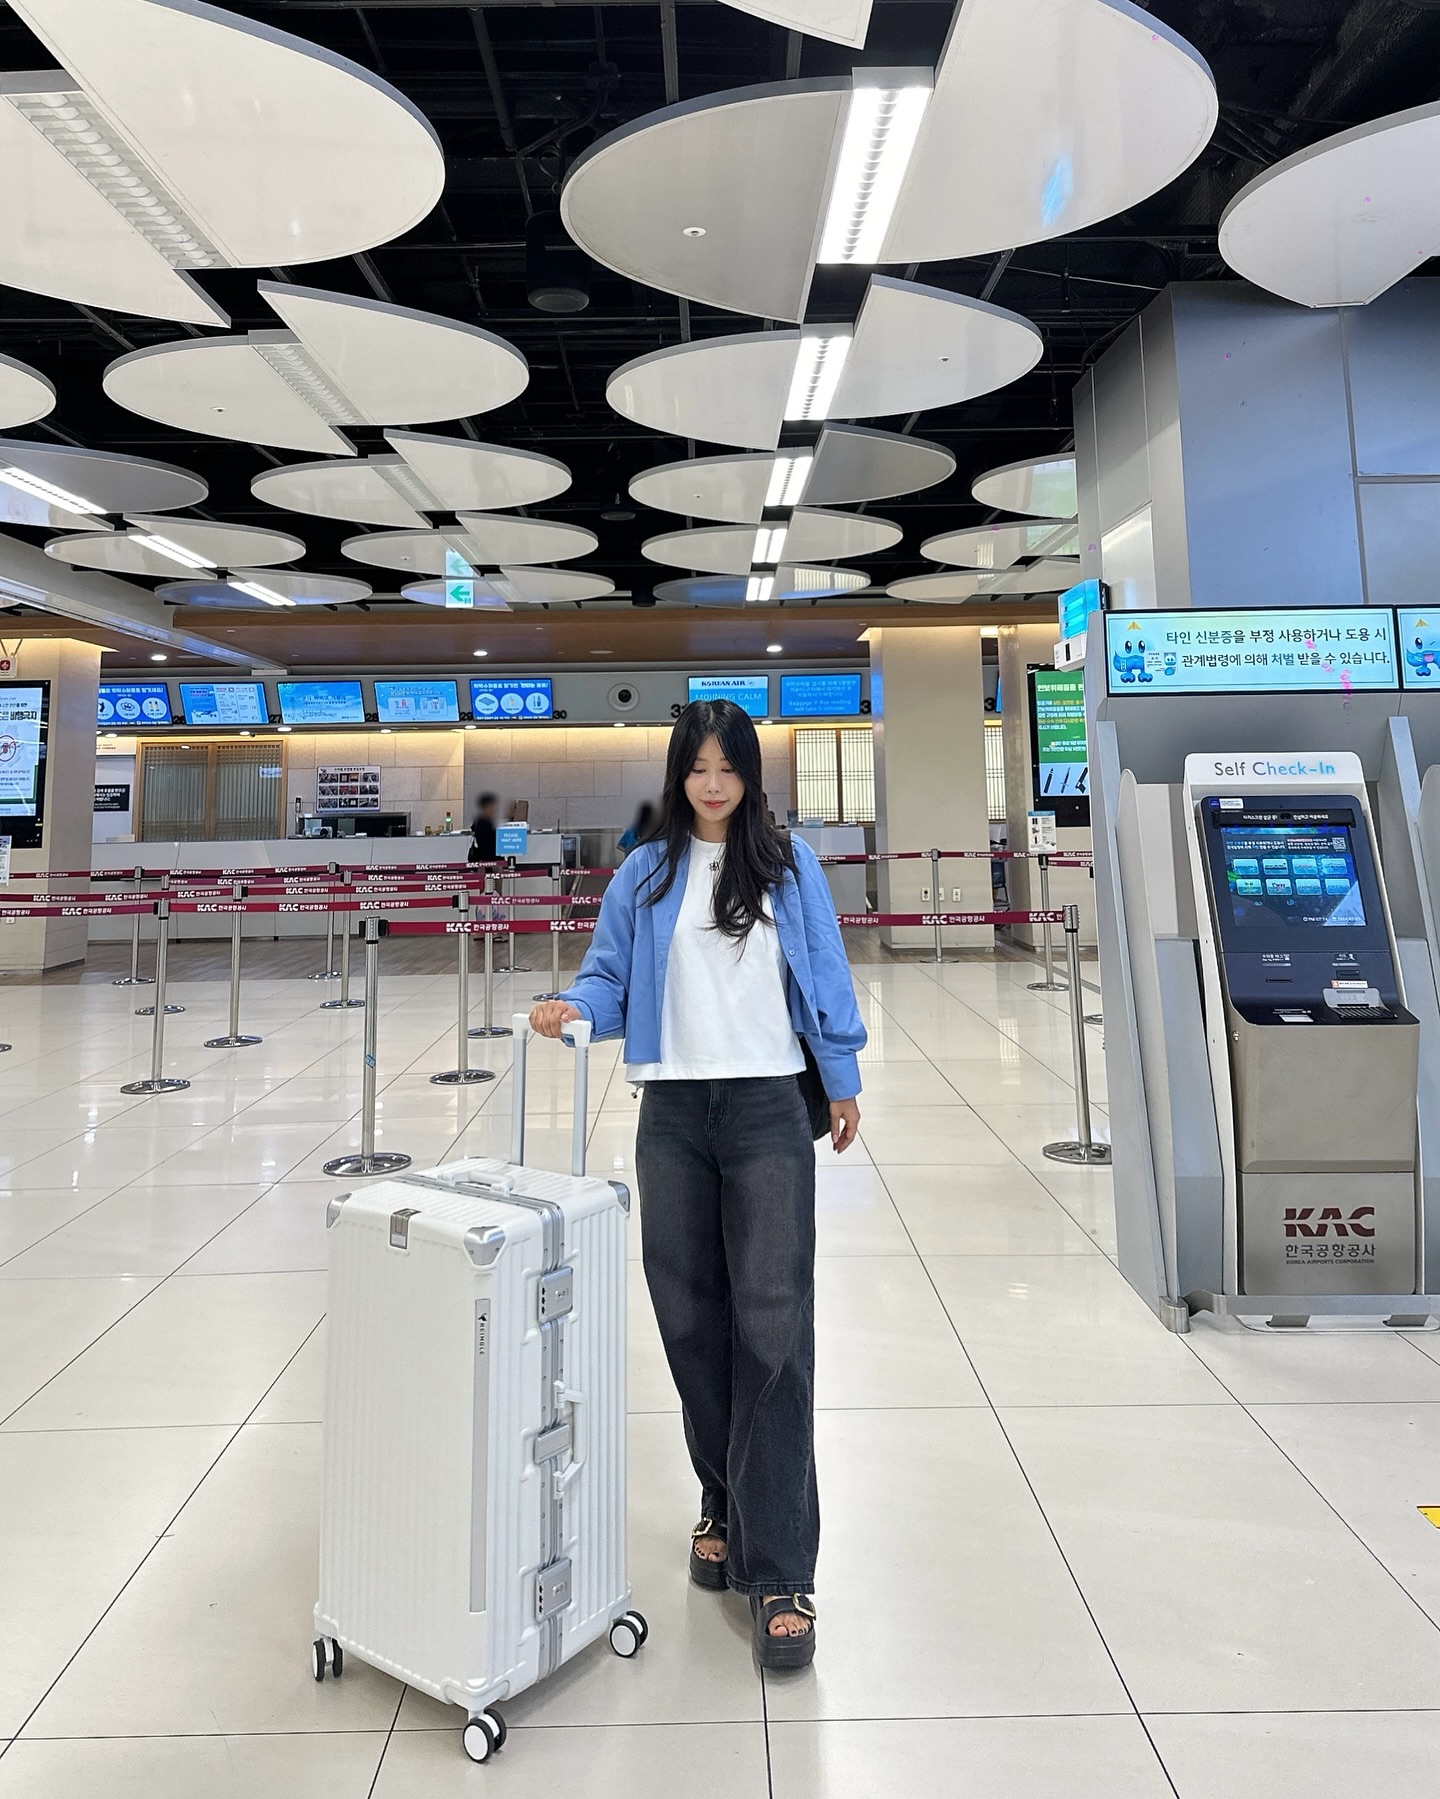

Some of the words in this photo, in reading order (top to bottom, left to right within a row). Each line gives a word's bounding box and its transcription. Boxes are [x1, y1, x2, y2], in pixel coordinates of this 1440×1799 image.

[1166, 631, 1192, 644] 타인
[1196, 630, 1245, 644] 신분증을
[1250, 629, 1274, 643] 부정
[1279, 628, 1341, 642] 사용하거나
[1345, 628, 1370, 641] 도용
[1375, 628, 1387, 641] 시
[1182, 654, 1242, 667] 관계법령에
[1244, 654, 1268, 666] 의해
[1271, 653, 1294, 666] 처벌
[1298, 653, 1321, 665] 받을
[1325, 653, 1336, 665] 수
[1340, 652, 1390, 665] 있습니다.
[366, 713, 378, 723] 28
[553, 710, 567, 720] 30
[1214, 761, 1246, 776] Self
[1252, 761, 1336, 776] Check-In
[572, 896, 592, 904] KAC
[62, 907, 82, 915] KAC
[197, 904, 217, 912] KAC
[279, 904, 299, 912] KAC
[922, 915, 947, 924] KAC
[948, 915, 985, 923] 한국공항공사
[1029, 912, 1055, 922] KAC
[446, 922, 471, 933] KAC
[473, 923, 509, 931] 한국공항공사
[550, 921, 575, 930] KAC
[577, 921, 597, 929] 한국공
[1283, 1206, 1375, 1237] KAC
[1285, 1243, 1376, 1258] 한국공항공사
